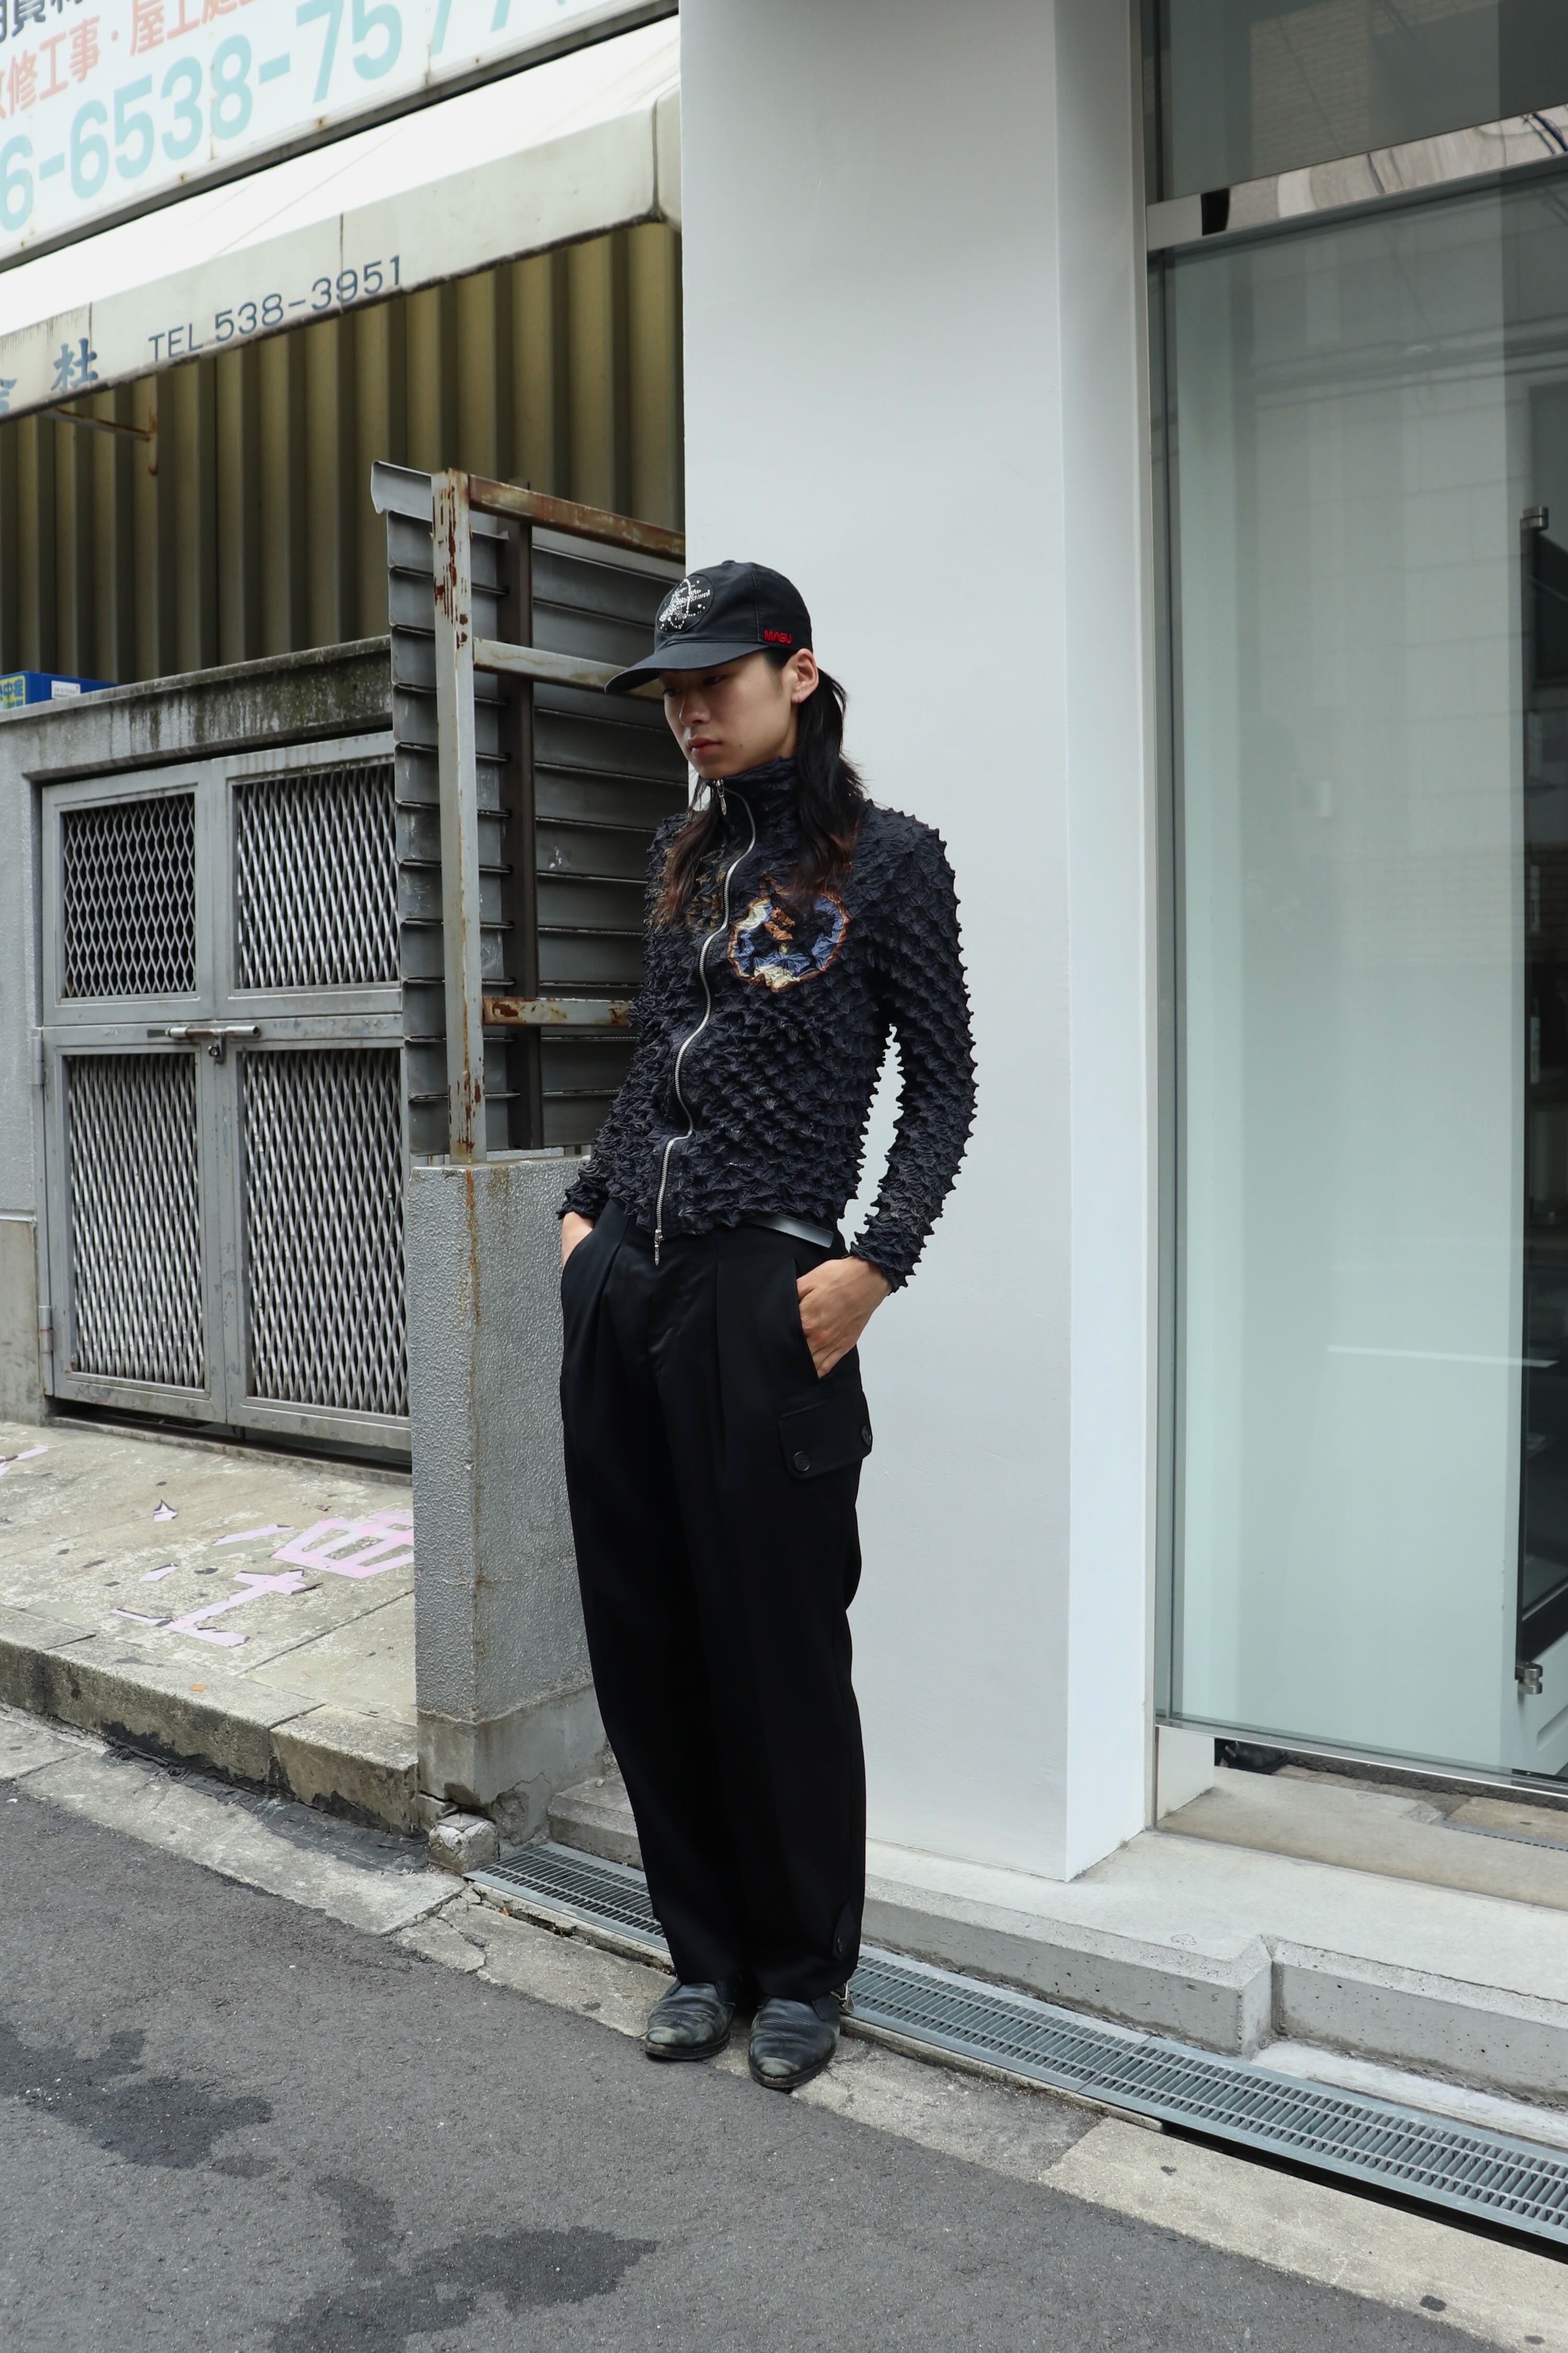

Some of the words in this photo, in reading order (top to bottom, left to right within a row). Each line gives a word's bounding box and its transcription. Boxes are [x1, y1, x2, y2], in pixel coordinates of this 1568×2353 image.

[148, 323, 203, 362] TEL
[214, 255, 401, 342] 538-3951
[764, 629, 792, 644] MASU
